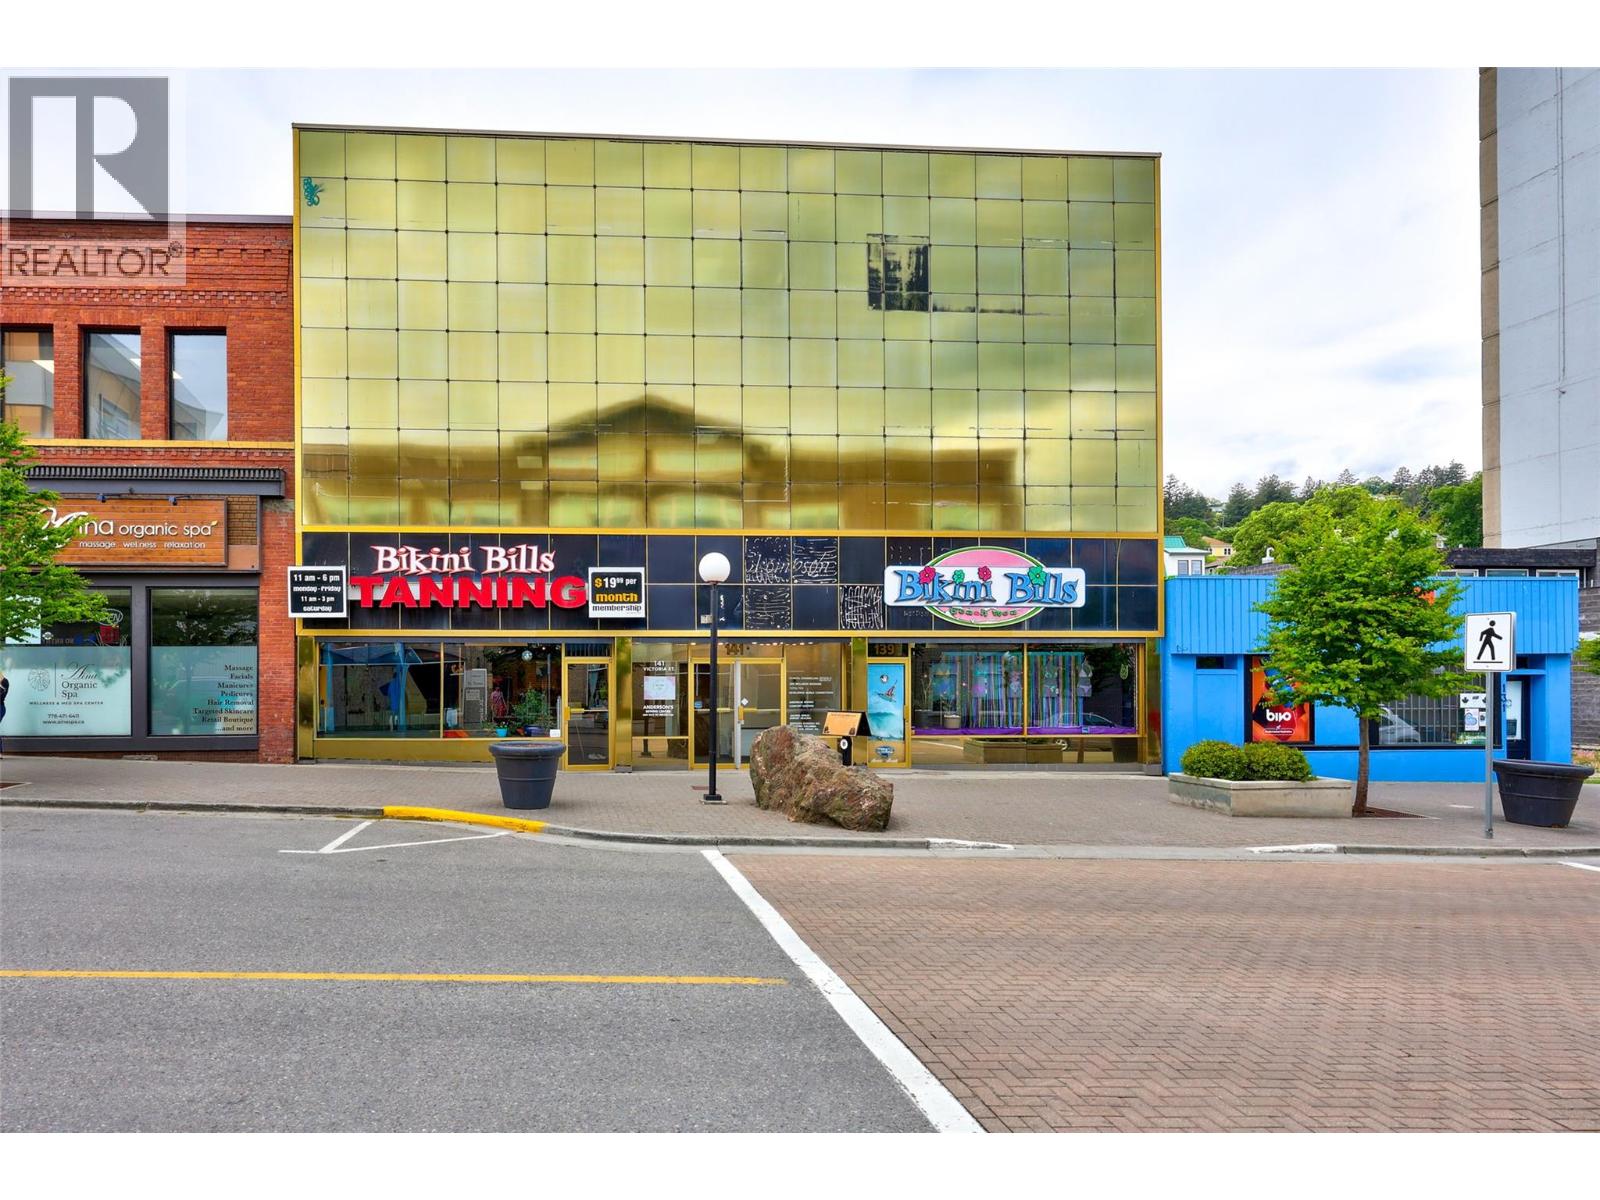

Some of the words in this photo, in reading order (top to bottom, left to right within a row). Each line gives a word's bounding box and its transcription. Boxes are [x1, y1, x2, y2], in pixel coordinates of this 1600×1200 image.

[118, 523, 179, 539] organic
[183, 525, 212, 539] spa
[79, 541, 116, 549] massage
[163, 540, 207, 549] relaxation
[370, 544, 476, 576] Bikini
[479, 544, 556, 574] Bills
[322, 574, 328, 582] 6
[329, 575, 340, 583] pm
[625, 578, 637, 586] per
[893, 566, 997, 605] Bikini
[1004, 566, 1079, 605] Bills
[349, 576, 588, 609] TANNING
[595, 592, 639, 602] month
[592, 604, 642, 612] membership
[724, 643, 744, 656] 141
[874, 643, 895, 655] 139
[224, 664, 254, 672] Massage
[61, 681, 98, 690] Organic
[61, 690, 78, 700] Spa
[223, 716, 253, 724] Boutique
